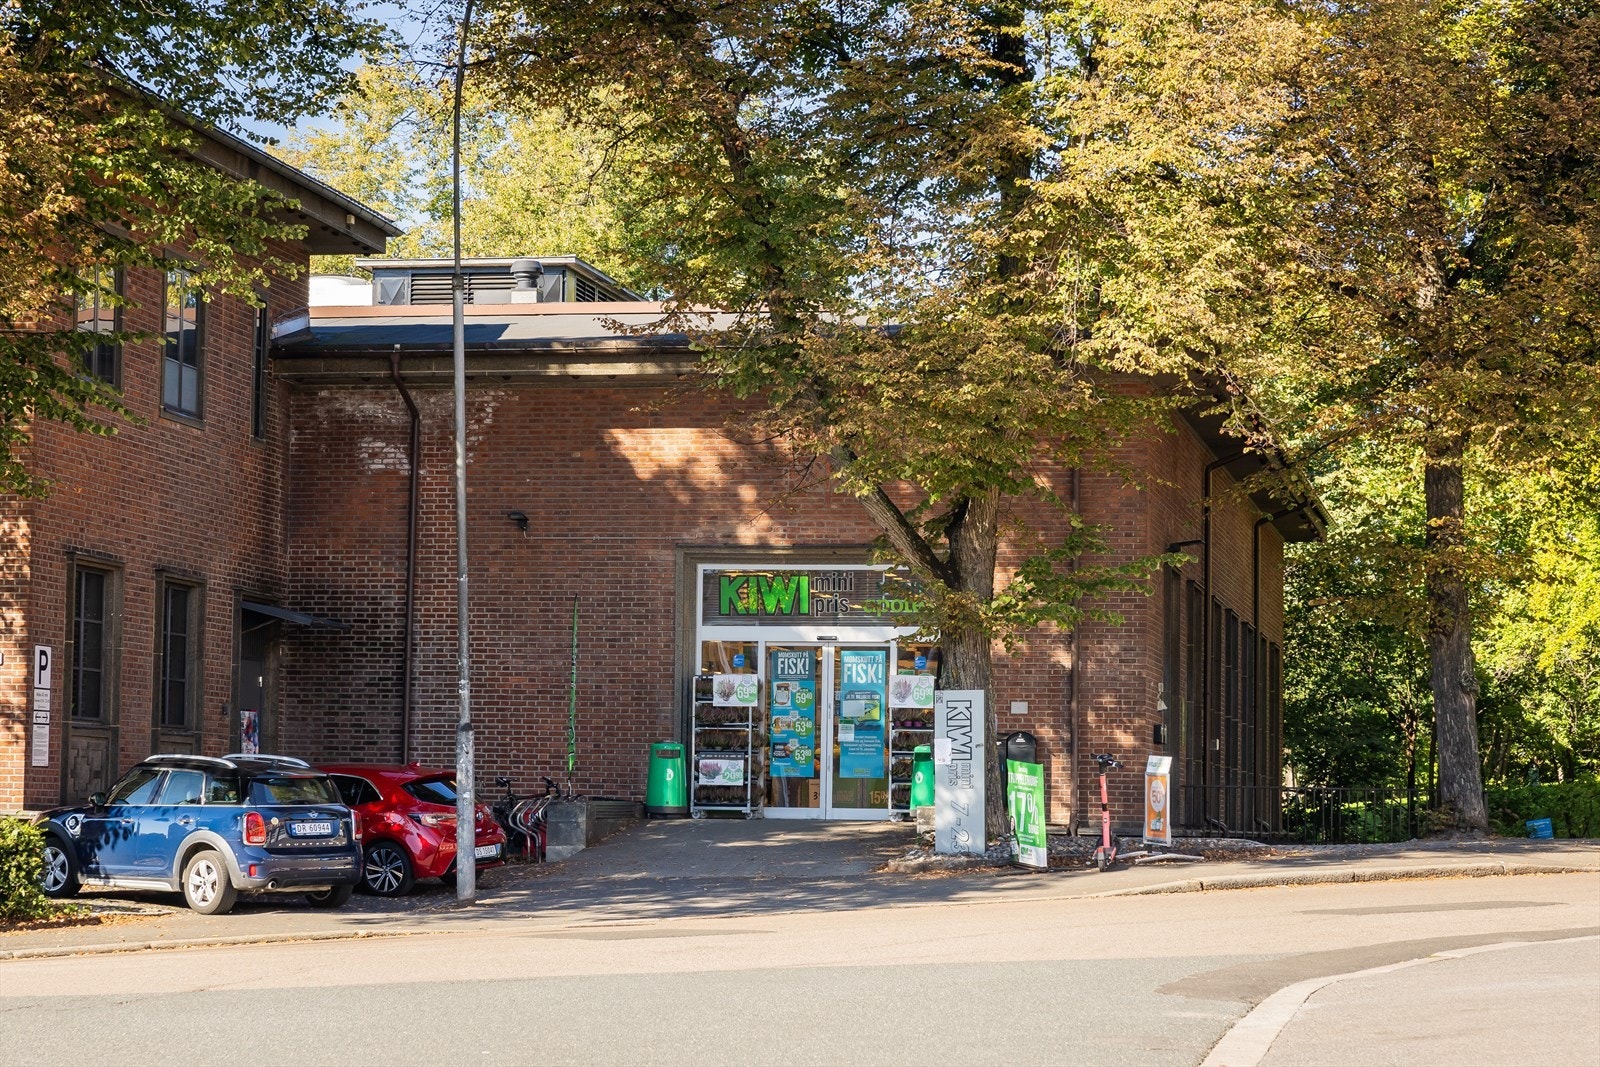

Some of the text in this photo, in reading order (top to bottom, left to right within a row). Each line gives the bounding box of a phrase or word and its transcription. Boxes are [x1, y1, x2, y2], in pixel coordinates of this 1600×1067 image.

[813, 572, 854, 592] mini
[719, 574, 811, 617] KIWI
[813, 593, 850, 617] pris
[38, 649, 49, 685] P
[777, 657, 809, 675] FISK!
[843, 663, 882, 684] FISK!
[946, 700, 972, 761] KIWI
[961, 762, 974, 790] mini
[1009, 790, 1039, 832] 17%
[297, 824, 330, 832] DR 60944
